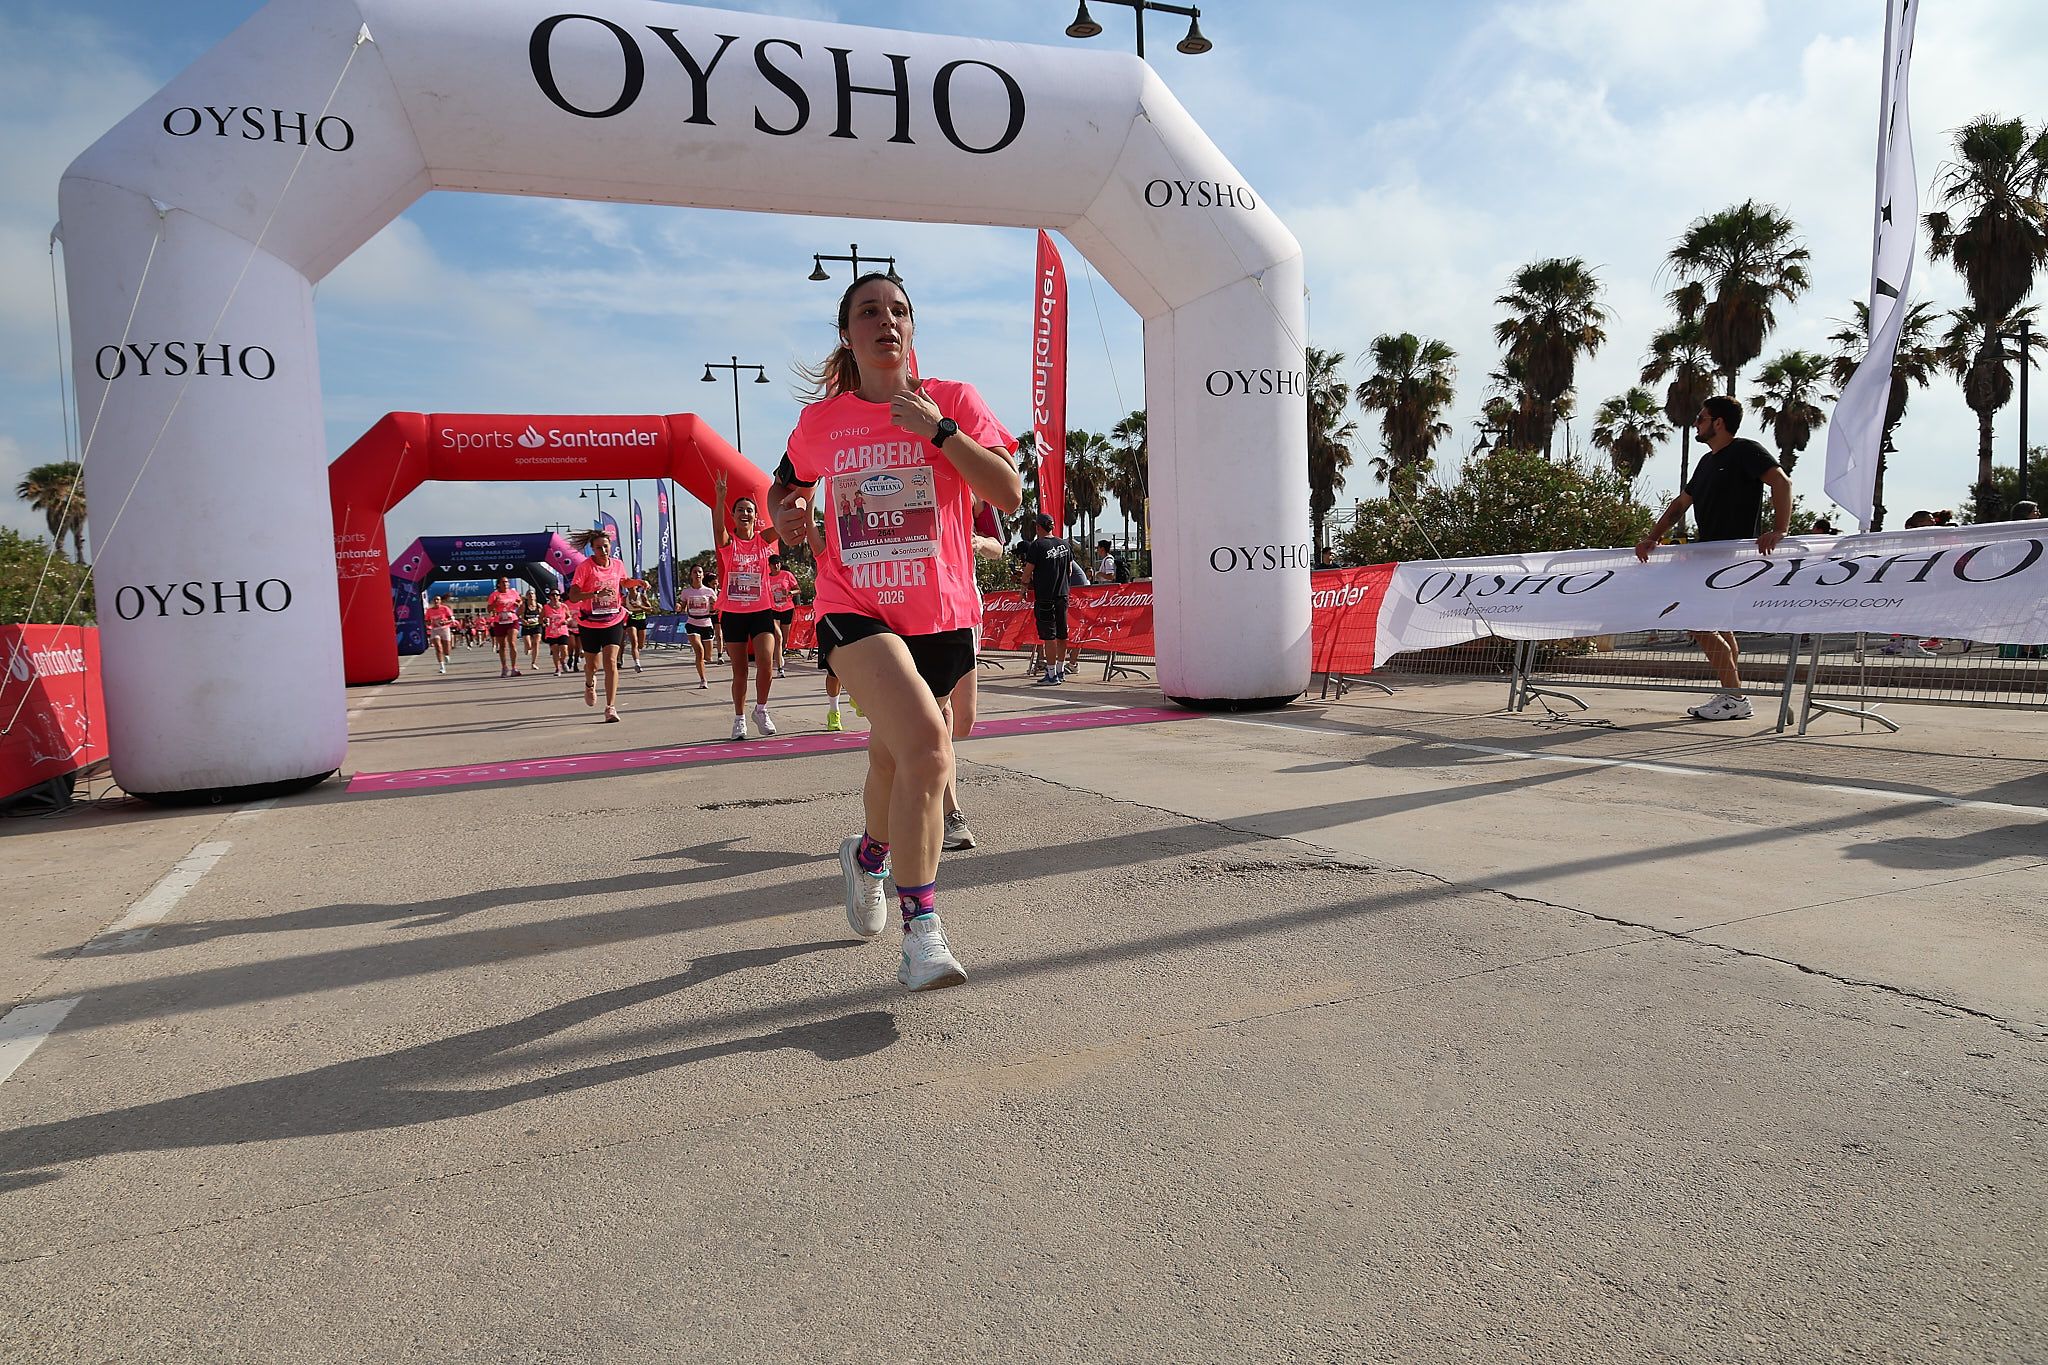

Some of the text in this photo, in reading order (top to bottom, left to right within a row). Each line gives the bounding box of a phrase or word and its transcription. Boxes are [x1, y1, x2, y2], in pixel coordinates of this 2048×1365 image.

[529, 14, 1026, 154] OYSHO
[163, 105, 354, 152] OYSHO
[1144, 179, 1257, 211] OYSHO
[95, 342, 276, 380] OYSHO
[1205, 368, 1306, 397] OYSHO
[441, 428, 658, 453] Sports Santander
[830, 426, 870, 440] OYSHO
[514, 455, 588, 465] sportssantander.es
[834, 441, 926, 473] CARRERA
[867, 510, 905, 528] 016
[905, 534, 929, 542] VALENCIA
[336, 549, 381, 559] antander
[440, 563, 514, 572] VOLVO
[851, 547, 929, 560] OYSHO Santander
[1209, 543, 1309, 573] OYSHO
[1705, 539, 2044, 590] OYSHO
[852, 561, 927, 589] MUJER
[1416, 570, 1615, 605] OYSHO
[115, 578, 292, 620] OYSHO
[877, 590, 905, 605] 2026
[1312, 583, 1370, 609] ander
